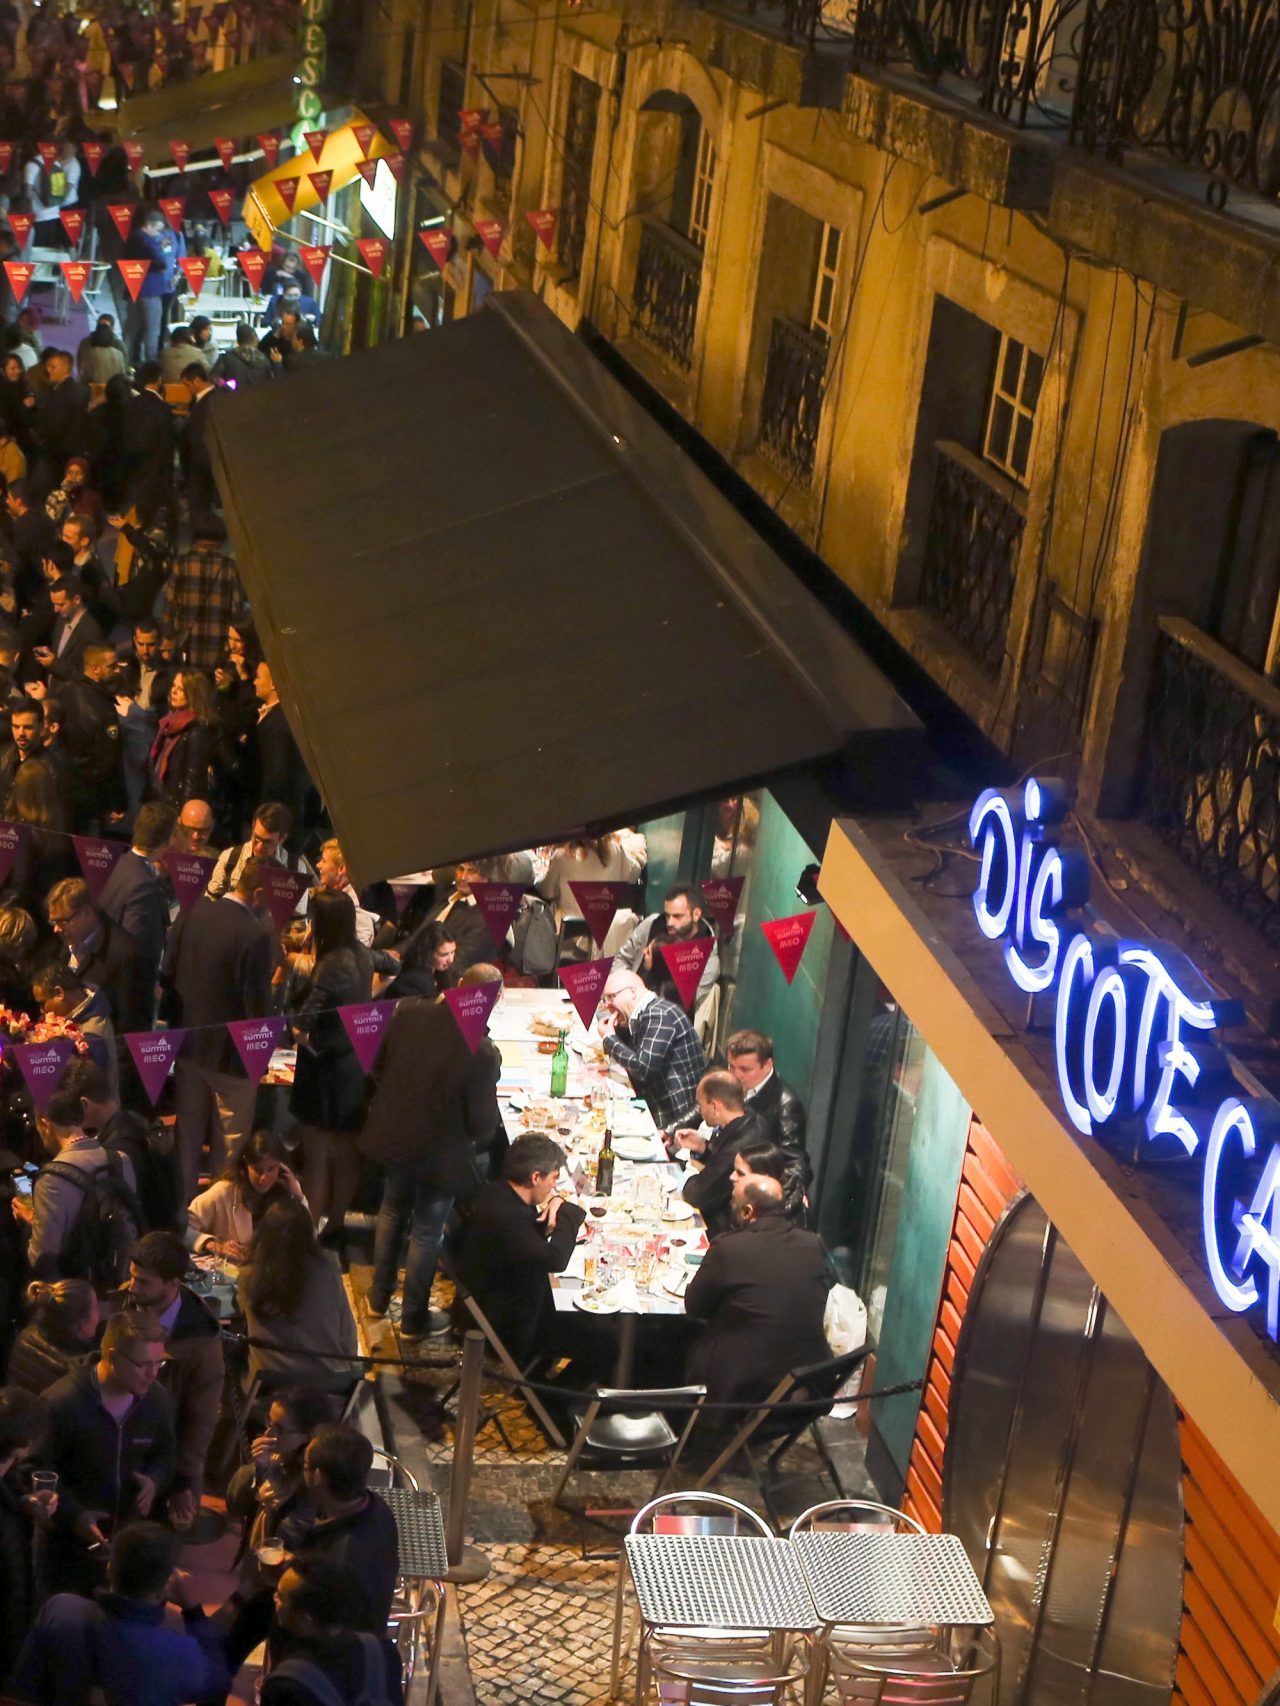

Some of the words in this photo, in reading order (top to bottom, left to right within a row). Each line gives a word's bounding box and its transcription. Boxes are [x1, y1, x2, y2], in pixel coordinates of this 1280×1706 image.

[459, 996, 486, 1007] summit
[354, 1014, 382, 1025] summit
[244, 1030, 272, 1041] summit
[141, 1044, 171, 1053] summit
[30, 1056, 60, 1064] summit
